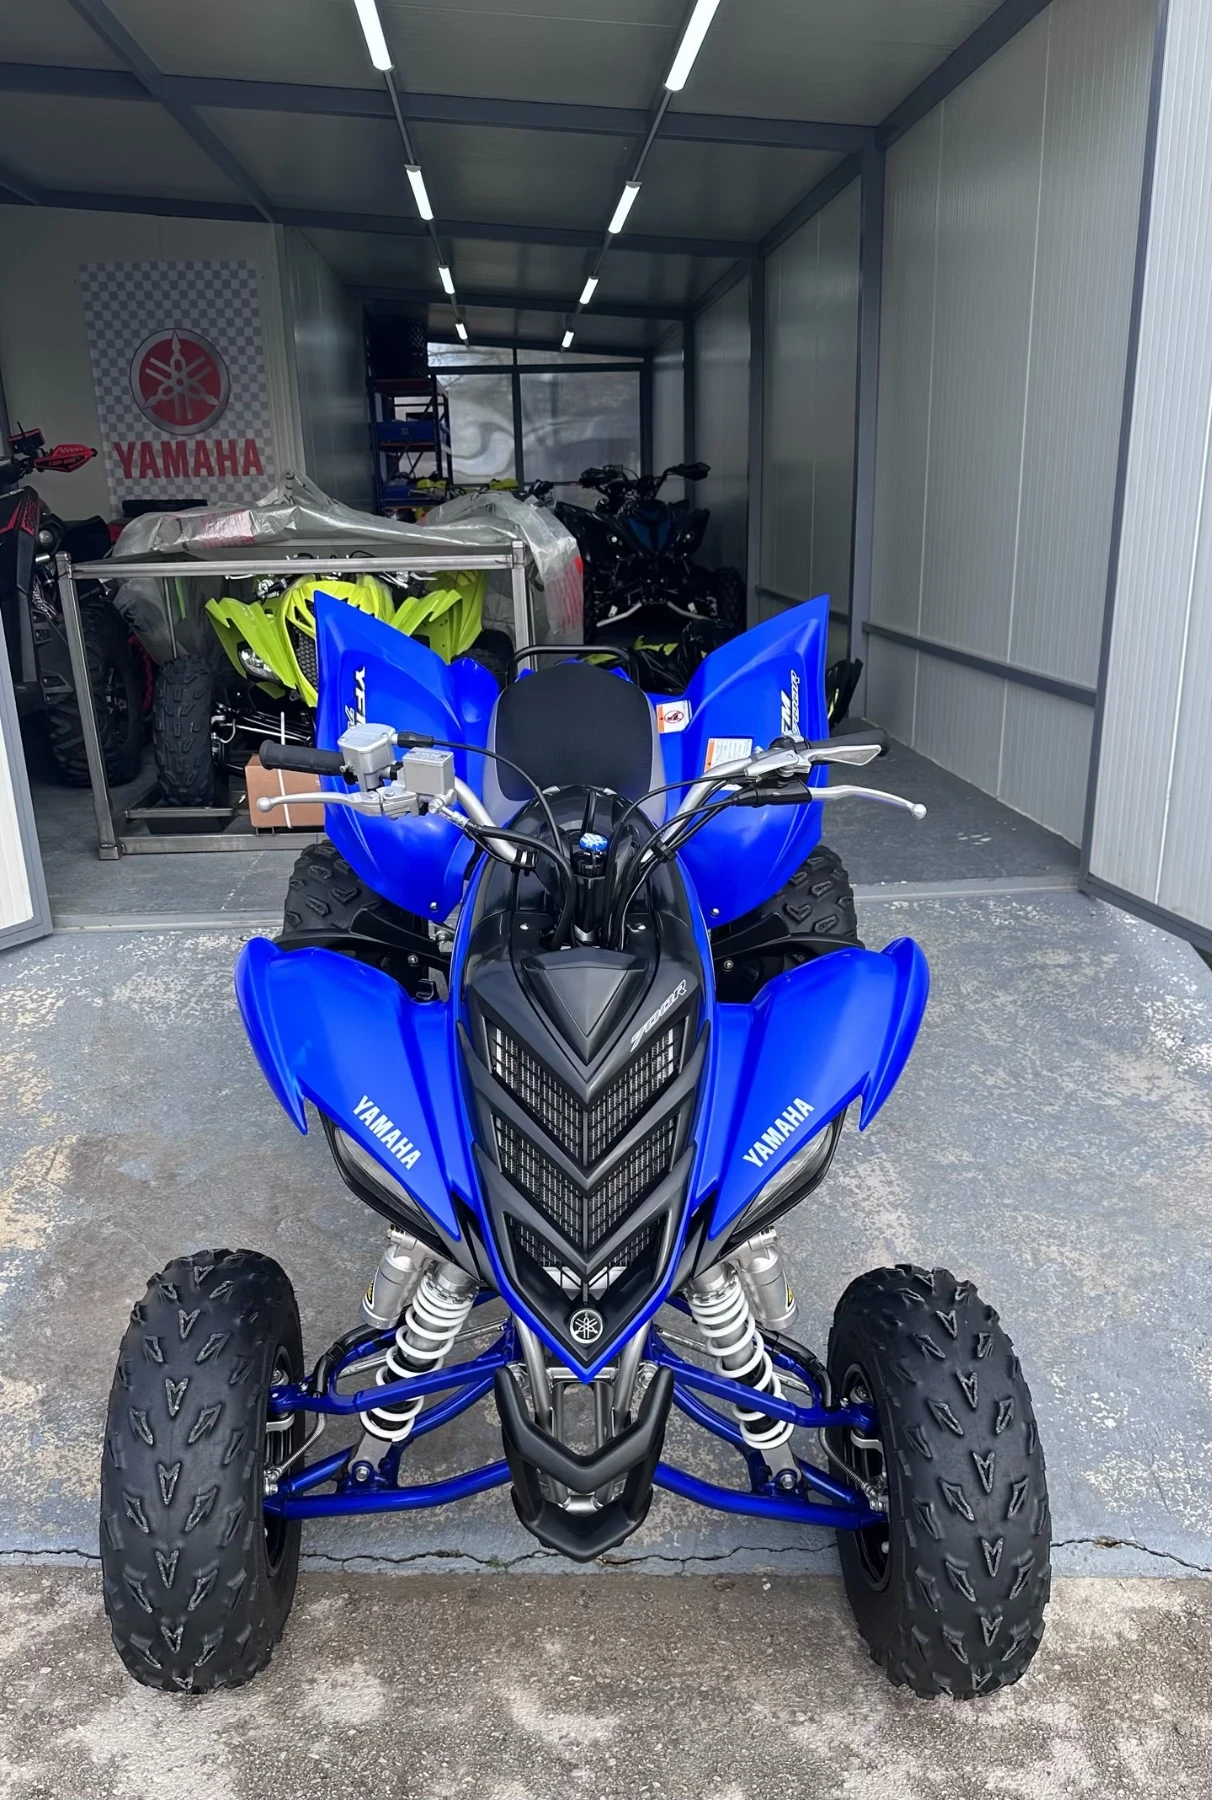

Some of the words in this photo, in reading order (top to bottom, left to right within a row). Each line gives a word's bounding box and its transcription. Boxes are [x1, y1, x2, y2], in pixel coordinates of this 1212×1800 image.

[113, 439, 264, 479] YAMAHA
[630, 979, 687, 1052] 700R
[353, 1094, 421, 1170] YAMAHA
[742, 1097, 815, 1168] YAMAHA
